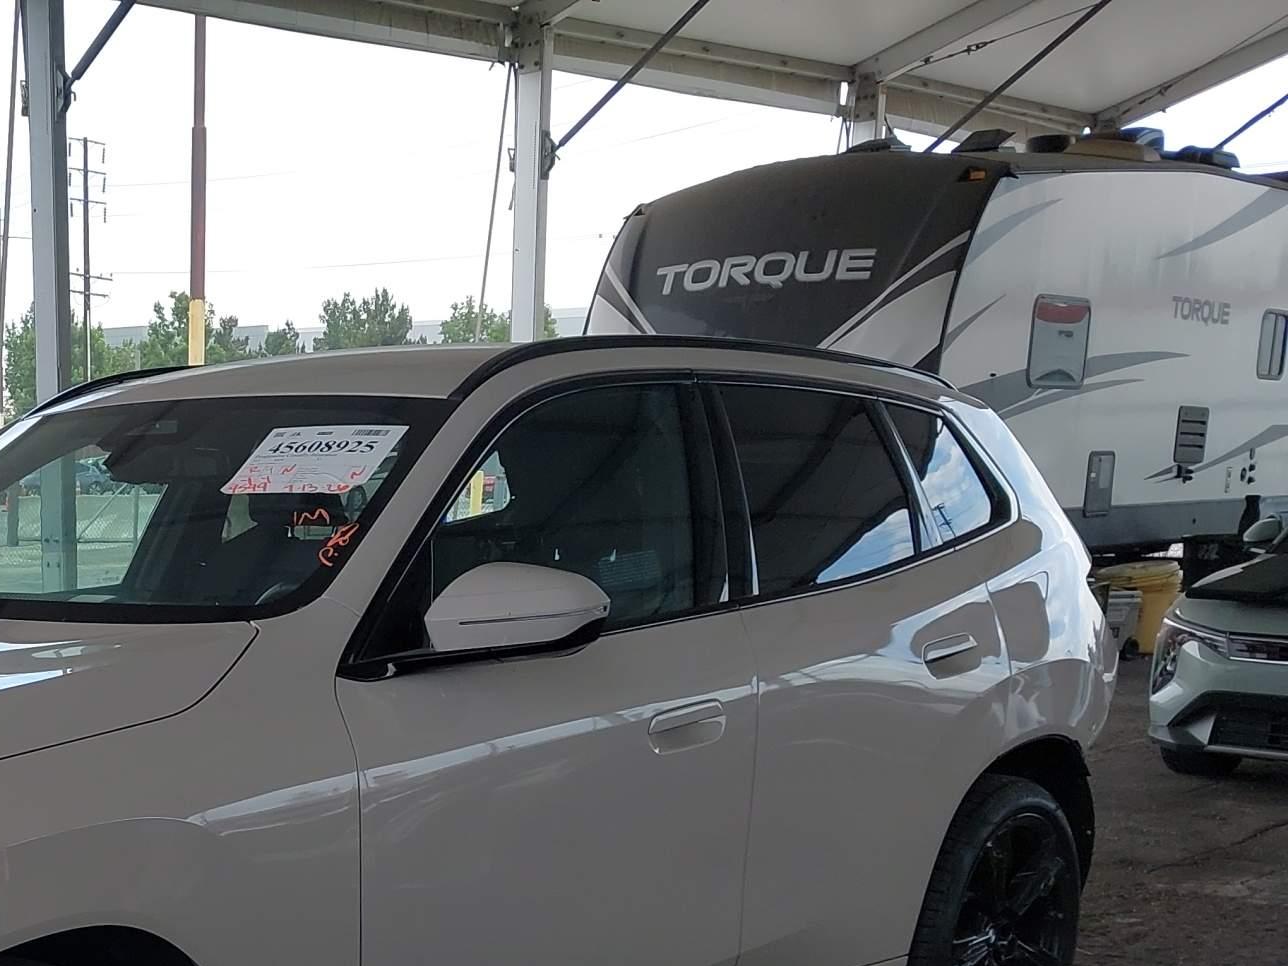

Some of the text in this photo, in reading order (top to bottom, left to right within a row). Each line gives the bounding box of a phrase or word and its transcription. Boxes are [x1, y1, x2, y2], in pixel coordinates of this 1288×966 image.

[656, 248, 877, 295] TORQUE
[1172, 296, 1231, 326] TORQUE
[268, 440, 378, 454] 45608925
